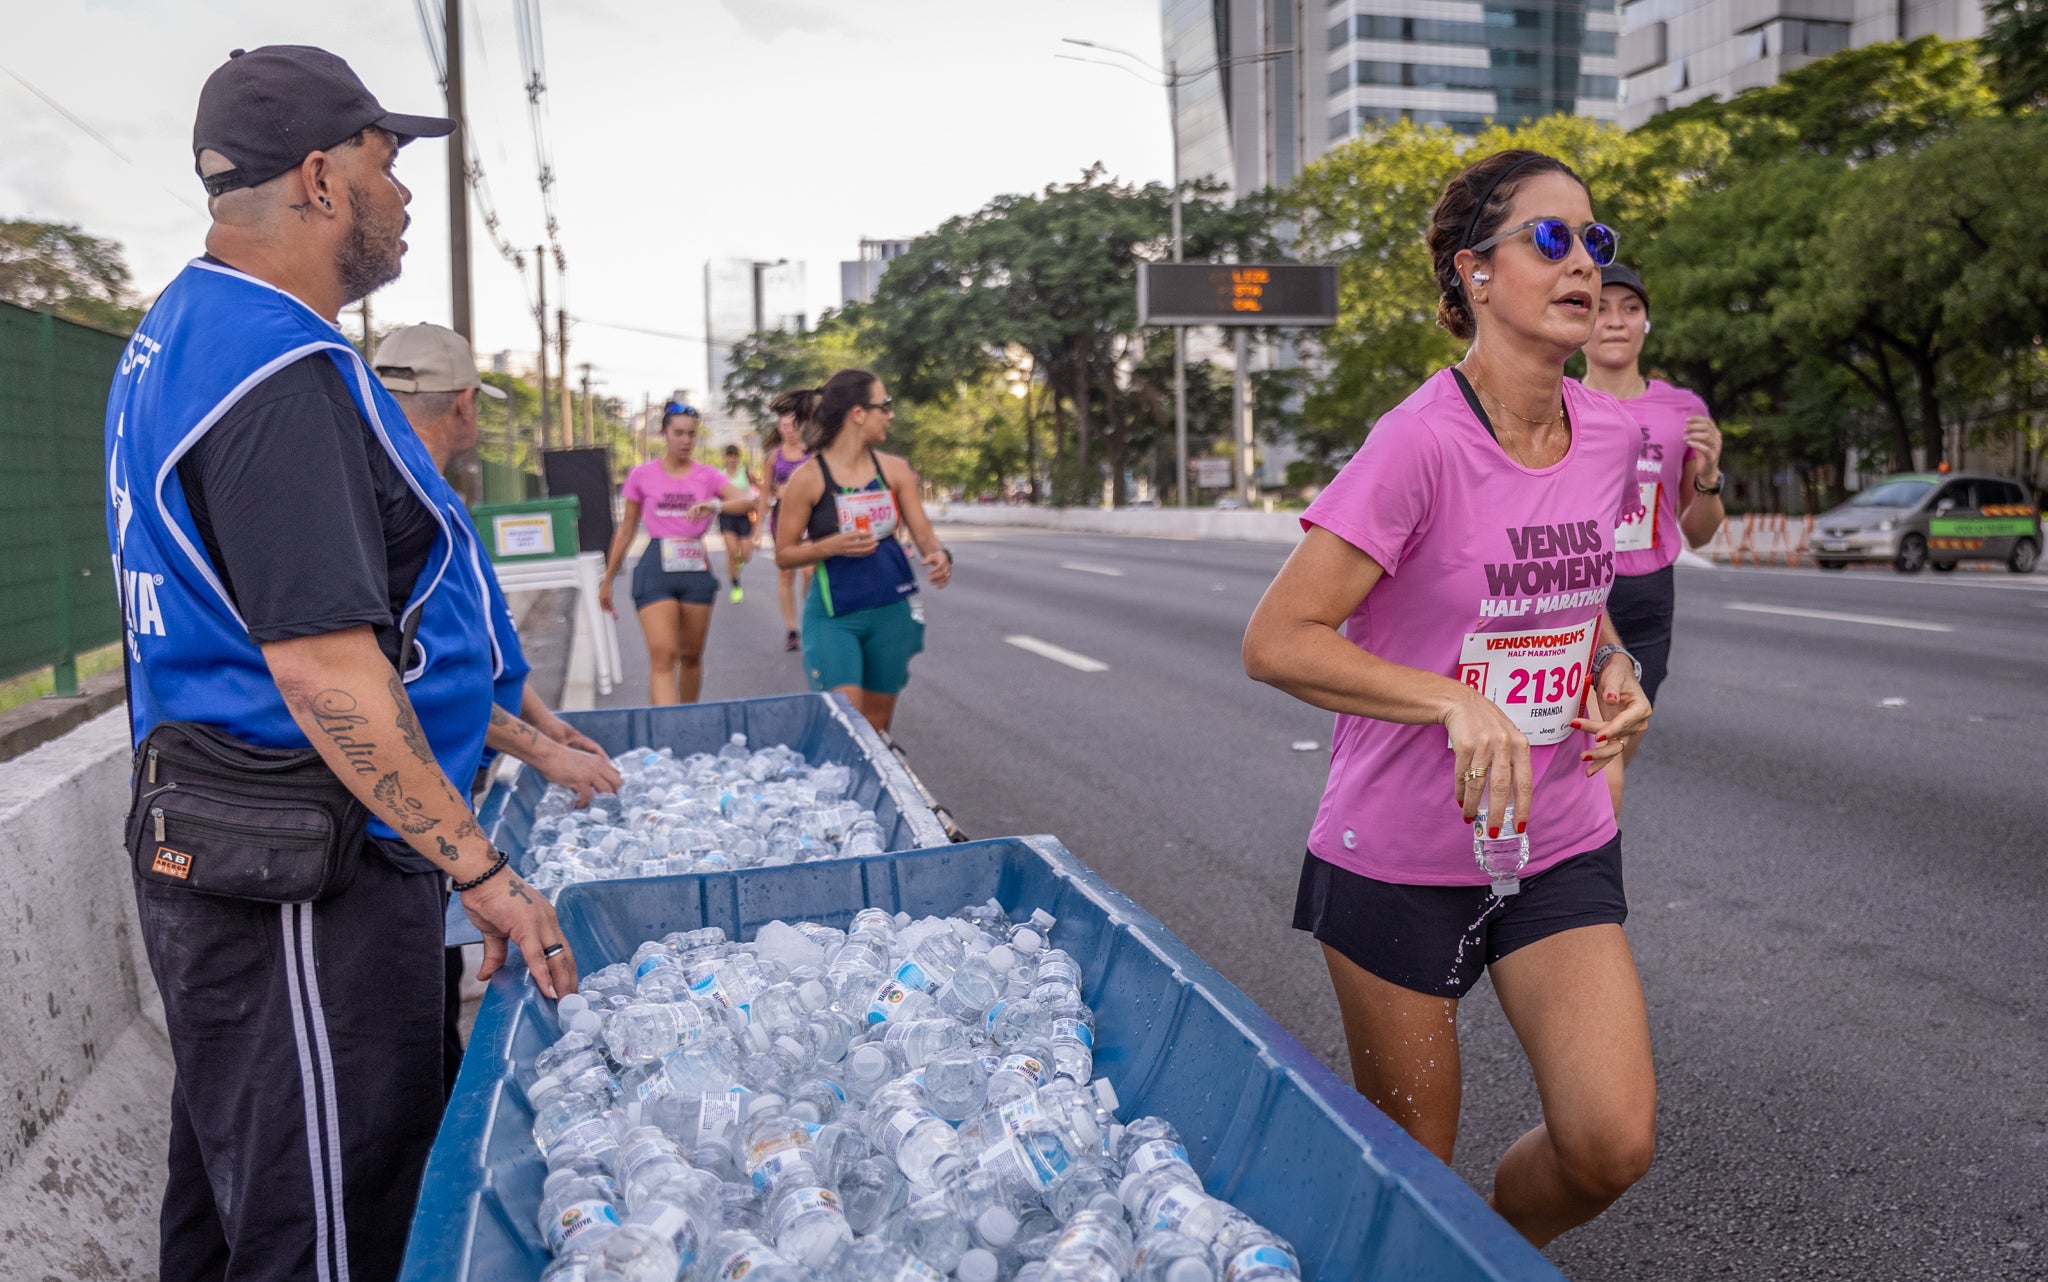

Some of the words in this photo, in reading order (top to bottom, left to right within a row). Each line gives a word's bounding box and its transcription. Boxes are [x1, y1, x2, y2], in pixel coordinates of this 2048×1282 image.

[1506, 519, 1602, 560] VENUS
[1483, 551, 1613, 597] WOMEN'S
[1479, 598, 1532, 617] HALF
[1507, 650, 1526, 658] HALF
[1527, 648, 1566, 657] MARATHON
[1505, 661, 1582, 704] 2130
[1530, 705, 1563, 717] FERNANDA
[311, 688, 377, 776] Lidia
[1539, 727, 1556, 735] Jeep
